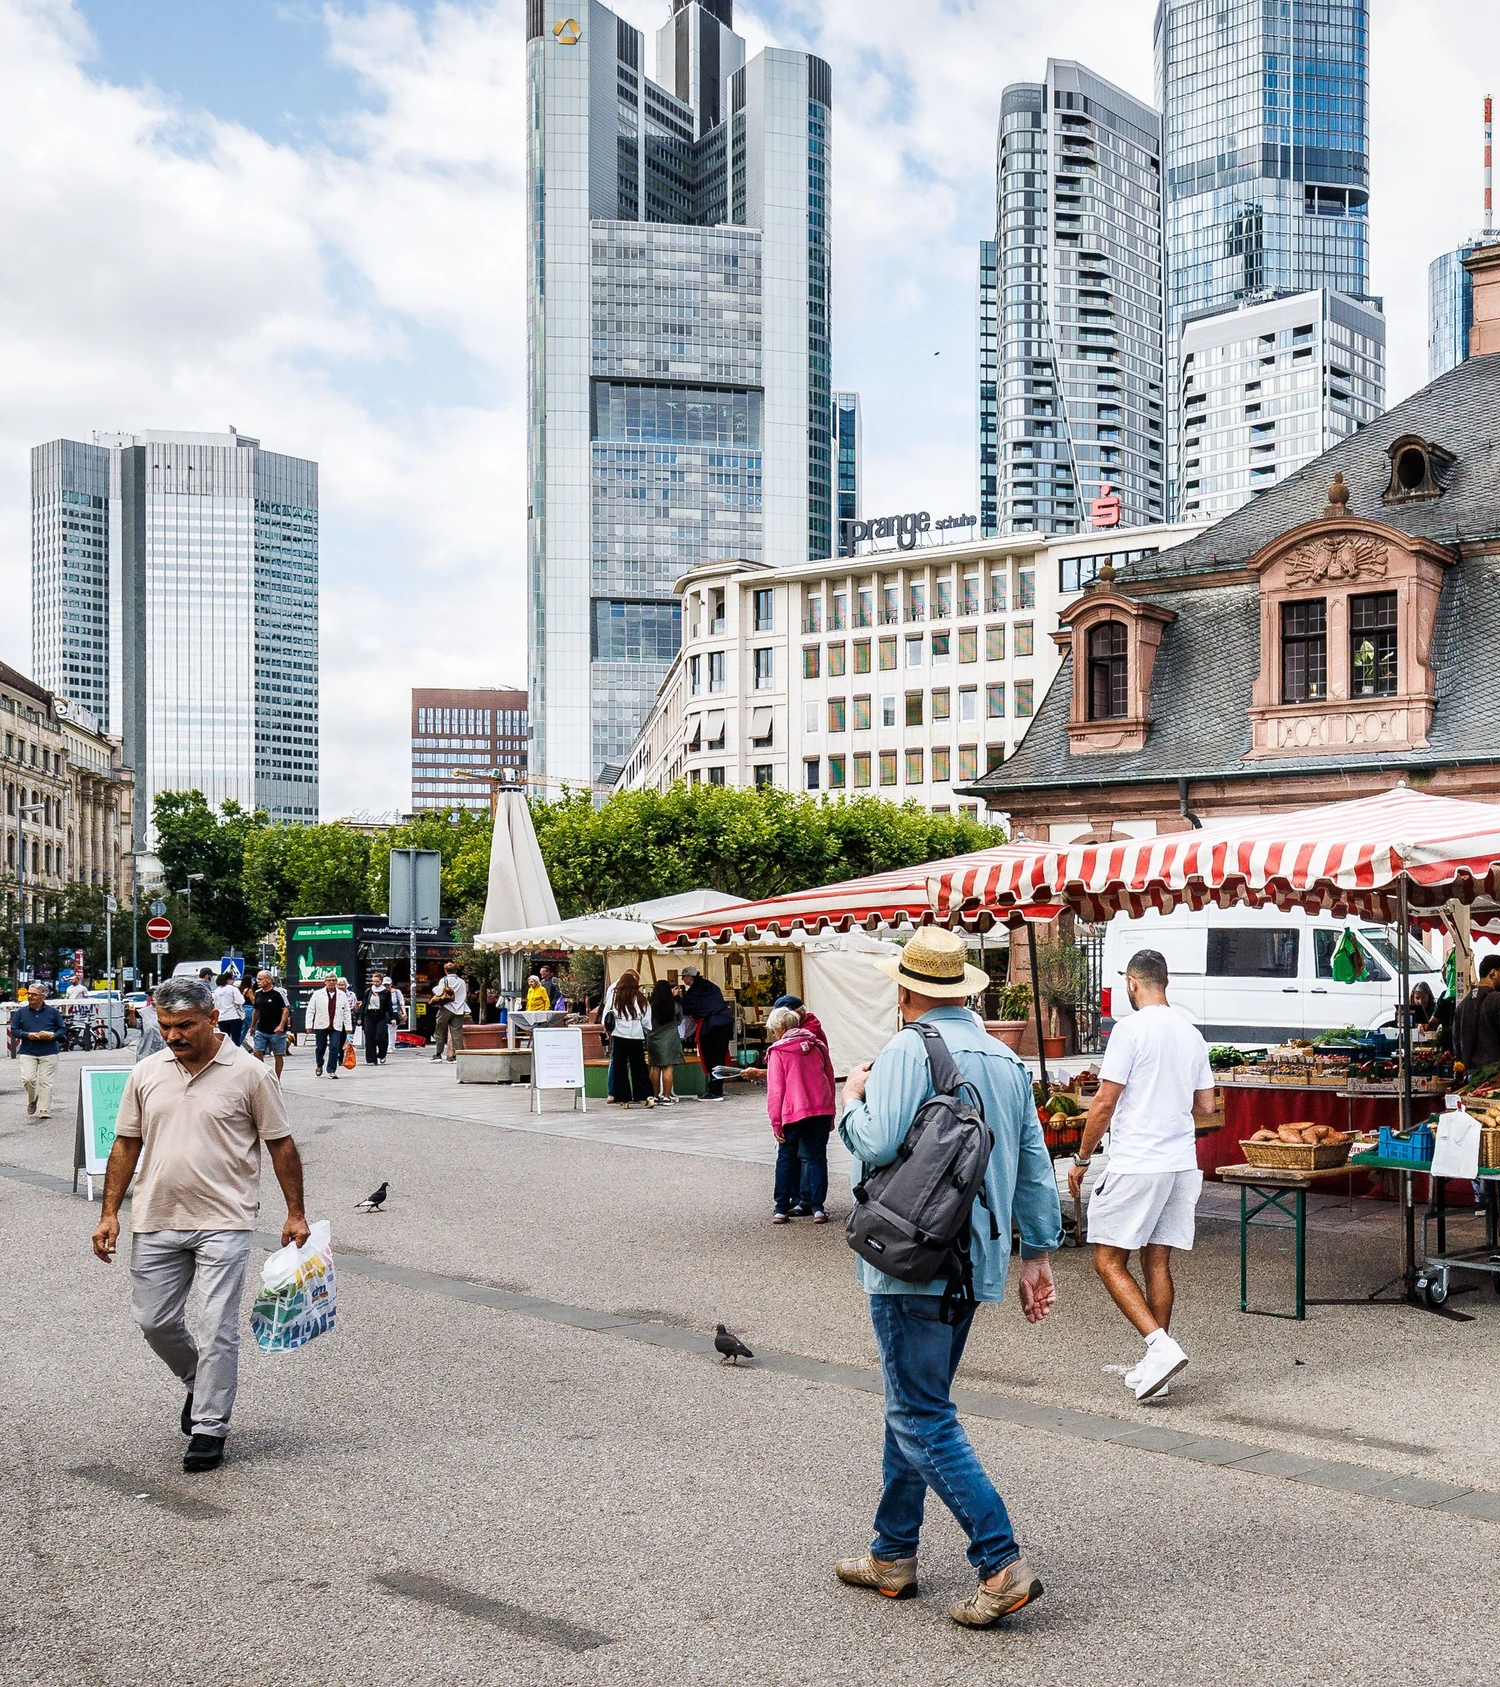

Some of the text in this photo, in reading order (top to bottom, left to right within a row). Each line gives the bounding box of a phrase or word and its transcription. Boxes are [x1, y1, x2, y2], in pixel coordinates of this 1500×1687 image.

[847, 511, 977, 557] prange schuhe
[312, 1284, 327, 1298] dm
